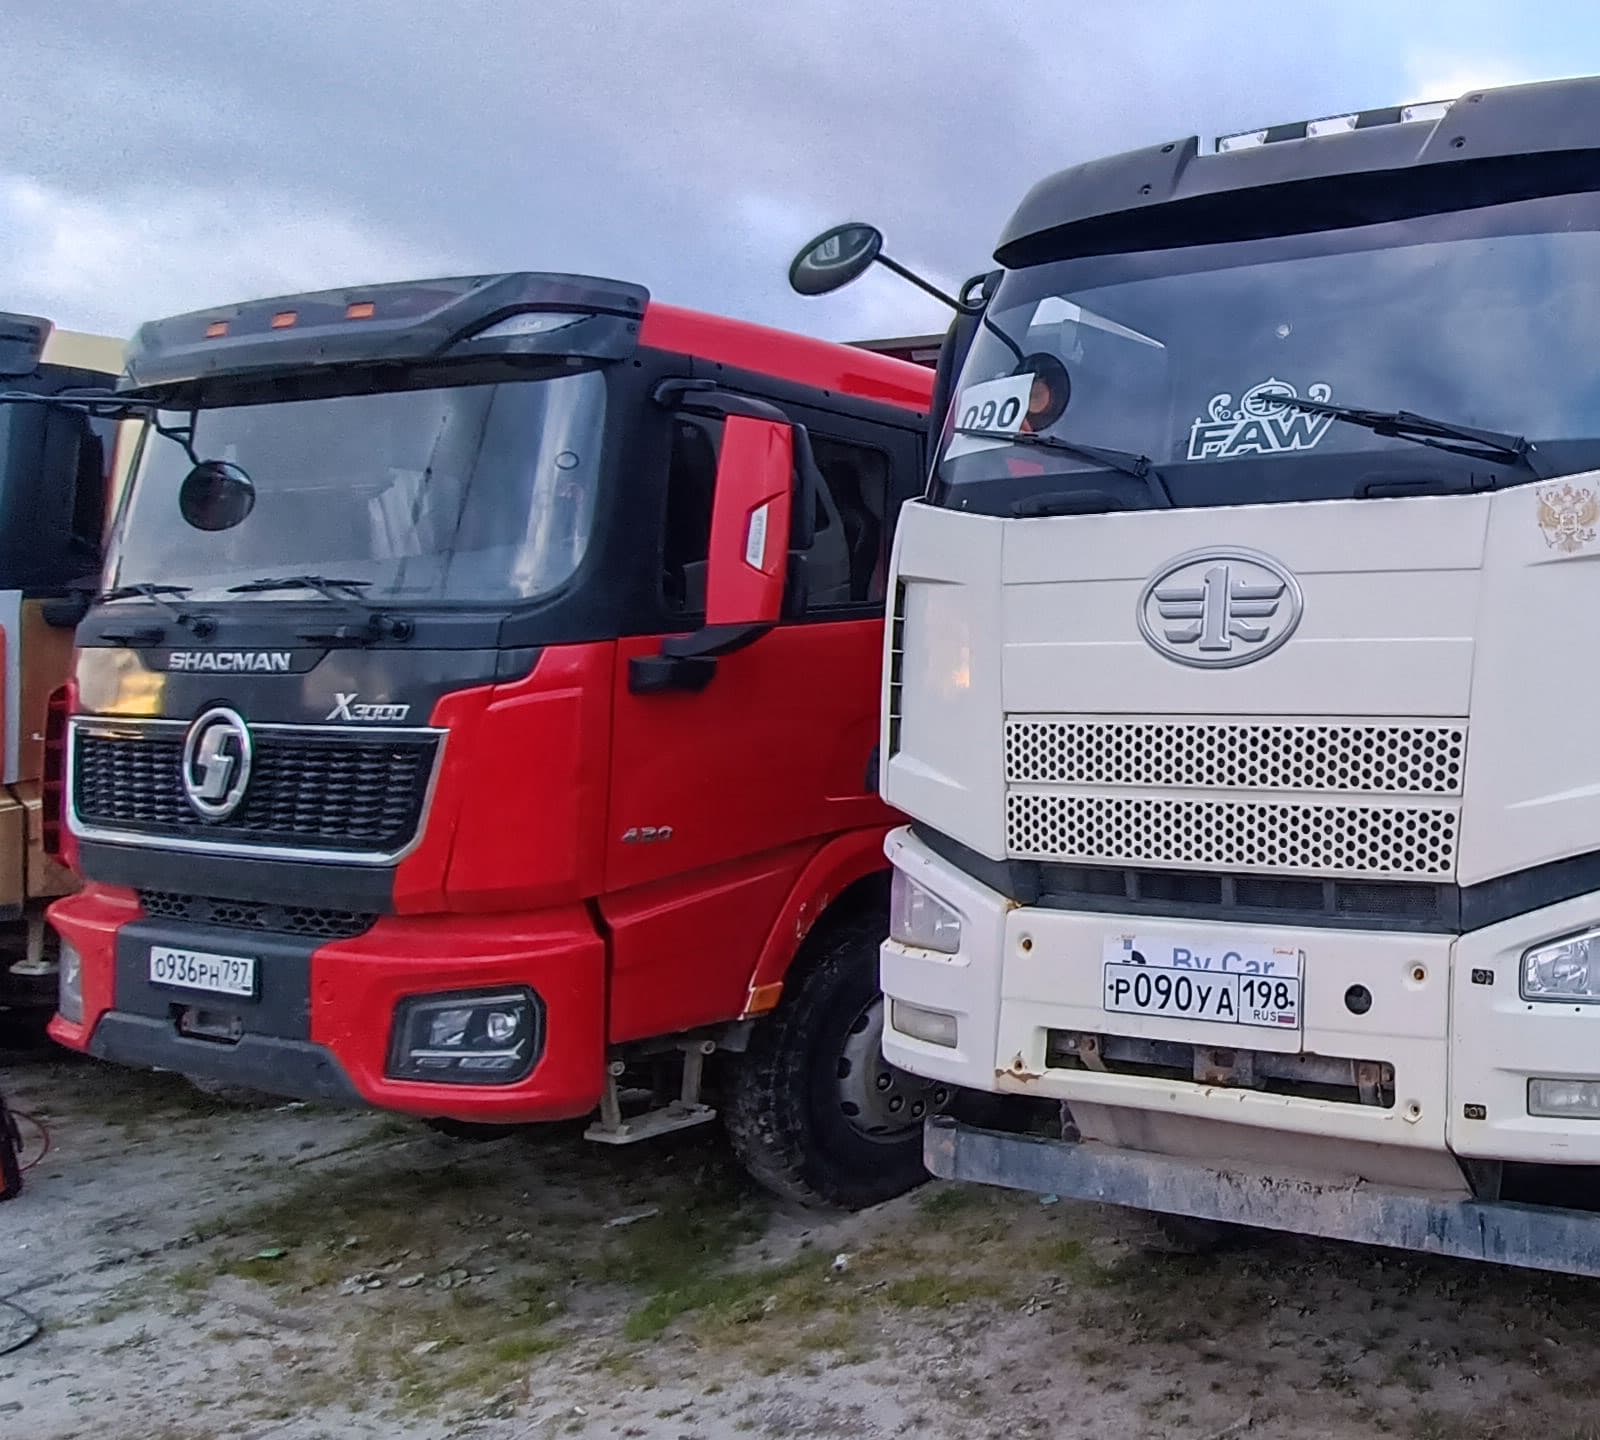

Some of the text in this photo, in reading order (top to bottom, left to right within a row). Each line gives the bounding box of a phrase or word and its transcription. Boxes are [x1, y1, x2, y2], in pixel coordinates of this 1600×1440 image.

[1187, 411, 1337, 460] FAW
[169, 652, 291, 671] SHACMAN
[326, 693, 410, 720] X3000
[1242, 980, 1289, 1010] 198
[1253, 1010, 1277, 1021] RUS
